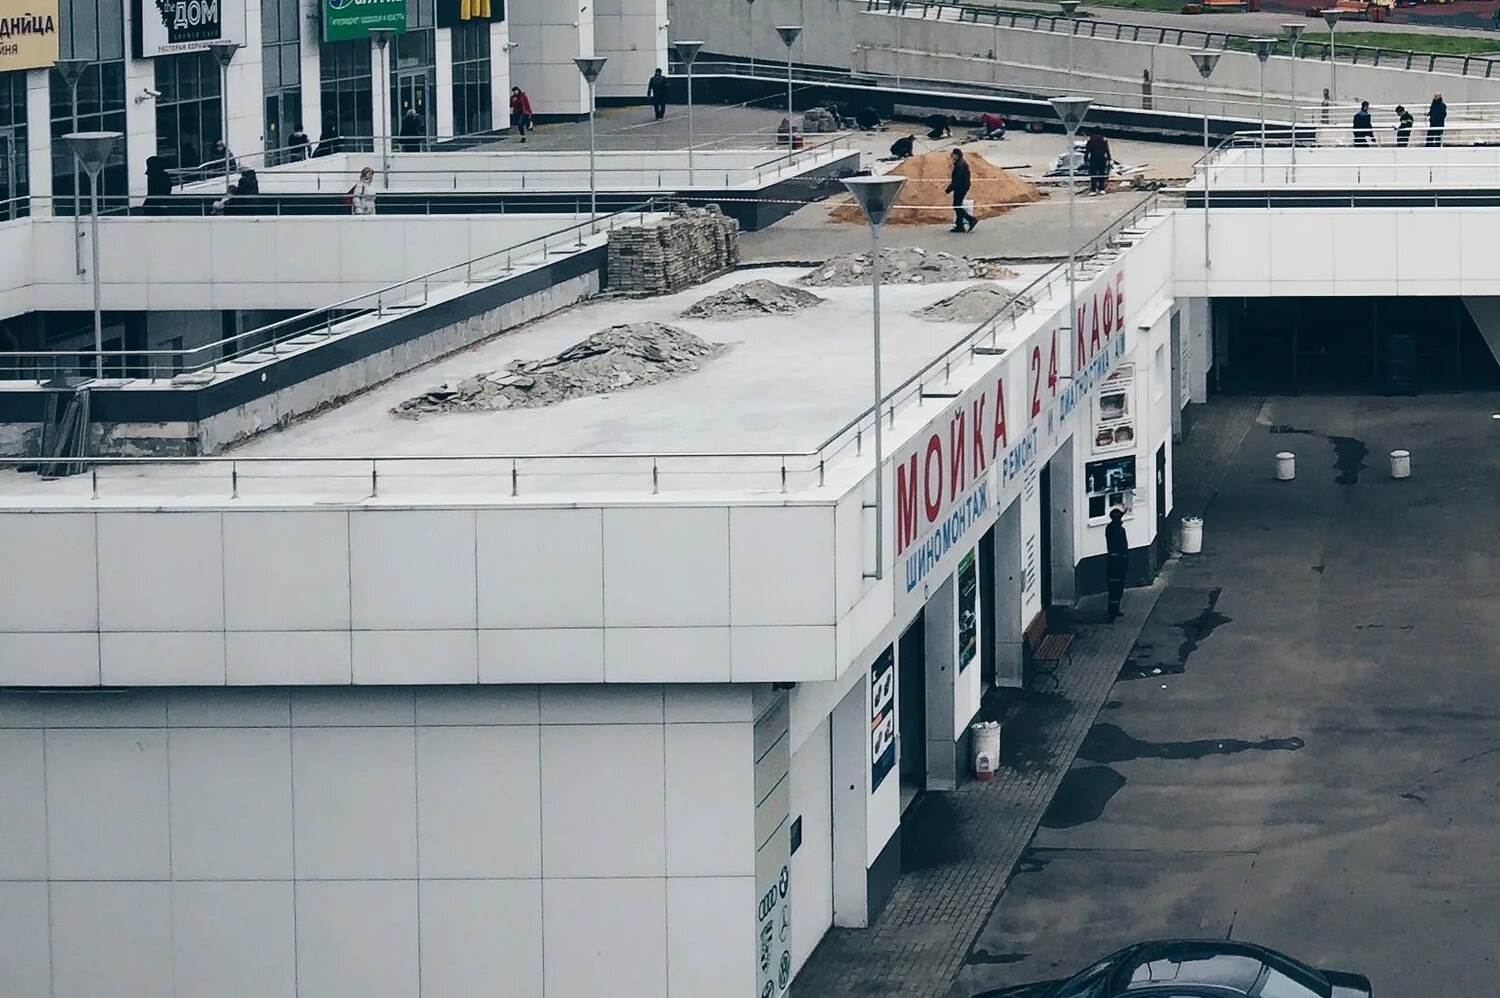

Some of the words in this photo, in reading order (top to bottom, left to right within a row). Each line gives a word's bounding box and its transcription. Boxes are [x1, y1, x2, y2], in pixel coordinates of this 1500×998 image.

[174, 0, 218, 29] ДОМ
[898, 379, 1007, 556] МОЙКА
[1031, 329, 1057, 419] 24
[1078, 270, 1124, 371] КАФЕ
[907, 480, 988, 593] ШИНОМОНТАЖ
[1003, 426, 1037, 488] РЕМОНТ
